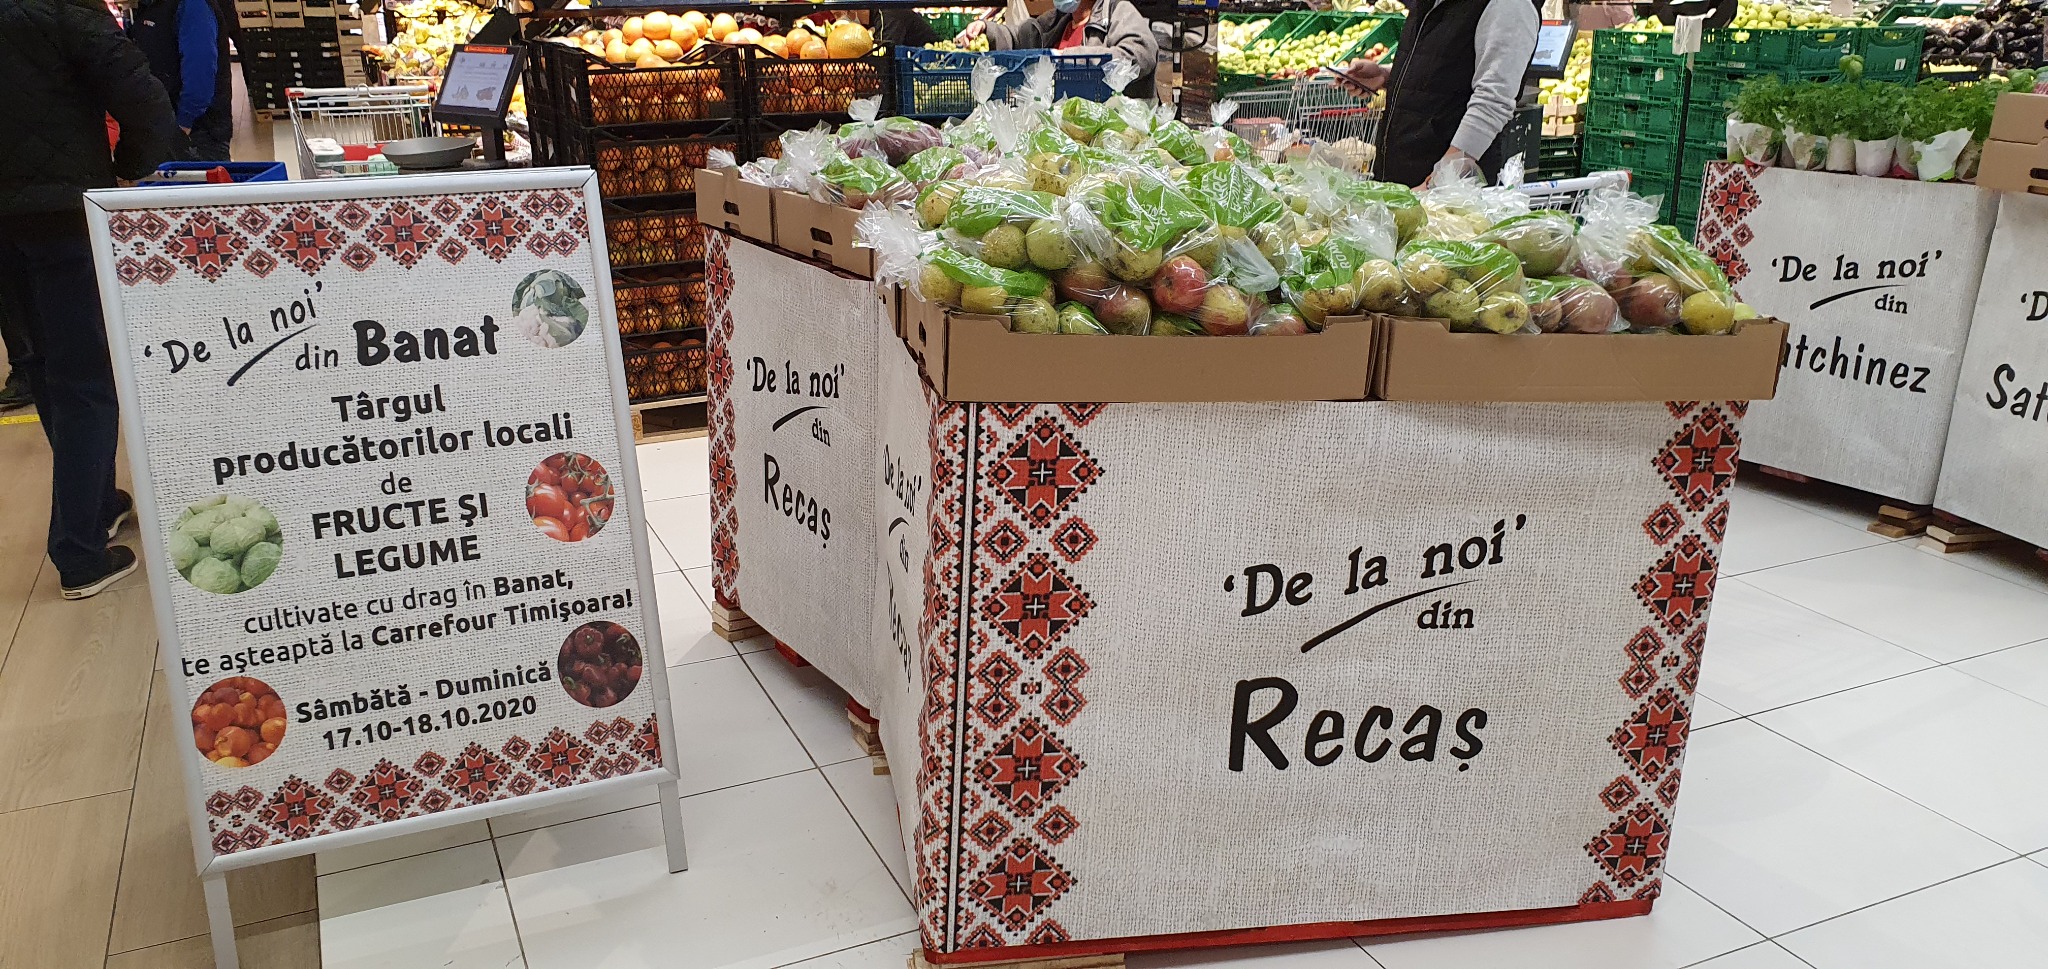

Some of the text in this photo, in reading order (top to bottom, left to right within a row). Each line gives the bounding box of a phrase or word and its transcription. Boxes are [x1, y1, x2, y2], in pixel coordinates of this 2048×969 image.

[1833, 254, 1859, 280] la
[1874, 294, 1907, 314] din
[223, 317, 254, 350] la
[295, 315, 500, 371] din Banat
[785, 360, 800, 394] la
[1986, 363, 2048, 421] Sat
[331, 384, 445, 422] Târgul
[213, 413, 573, 485] producătorilor locali
[811, 418, 831, 447] din
[381, 471, 412, 494] de
[896, 456, 904, 500] la
[312, 496, 449, 540] FRUCTE
[764, 453, 831, 549] Recaș
[335, 535, 481, 579] LEGUME
[900, 534, 909, 573] din
[1344, 546, 1388, 595] la
[243, 569, 573, 634] cultivate cu drag în Banat,
[1417, 600, 1474, 629] din
[181, 657, 209, 678] te
[343, 629, 363, 652] la
[371, 610, 497, 648] Carrefour
[295, 660, 551, 724] Sâmbătă - Duminică
[323, 695, 537, 751] 17.10-18.10.2020
[1228, 676, 1488, 773] Recaș
